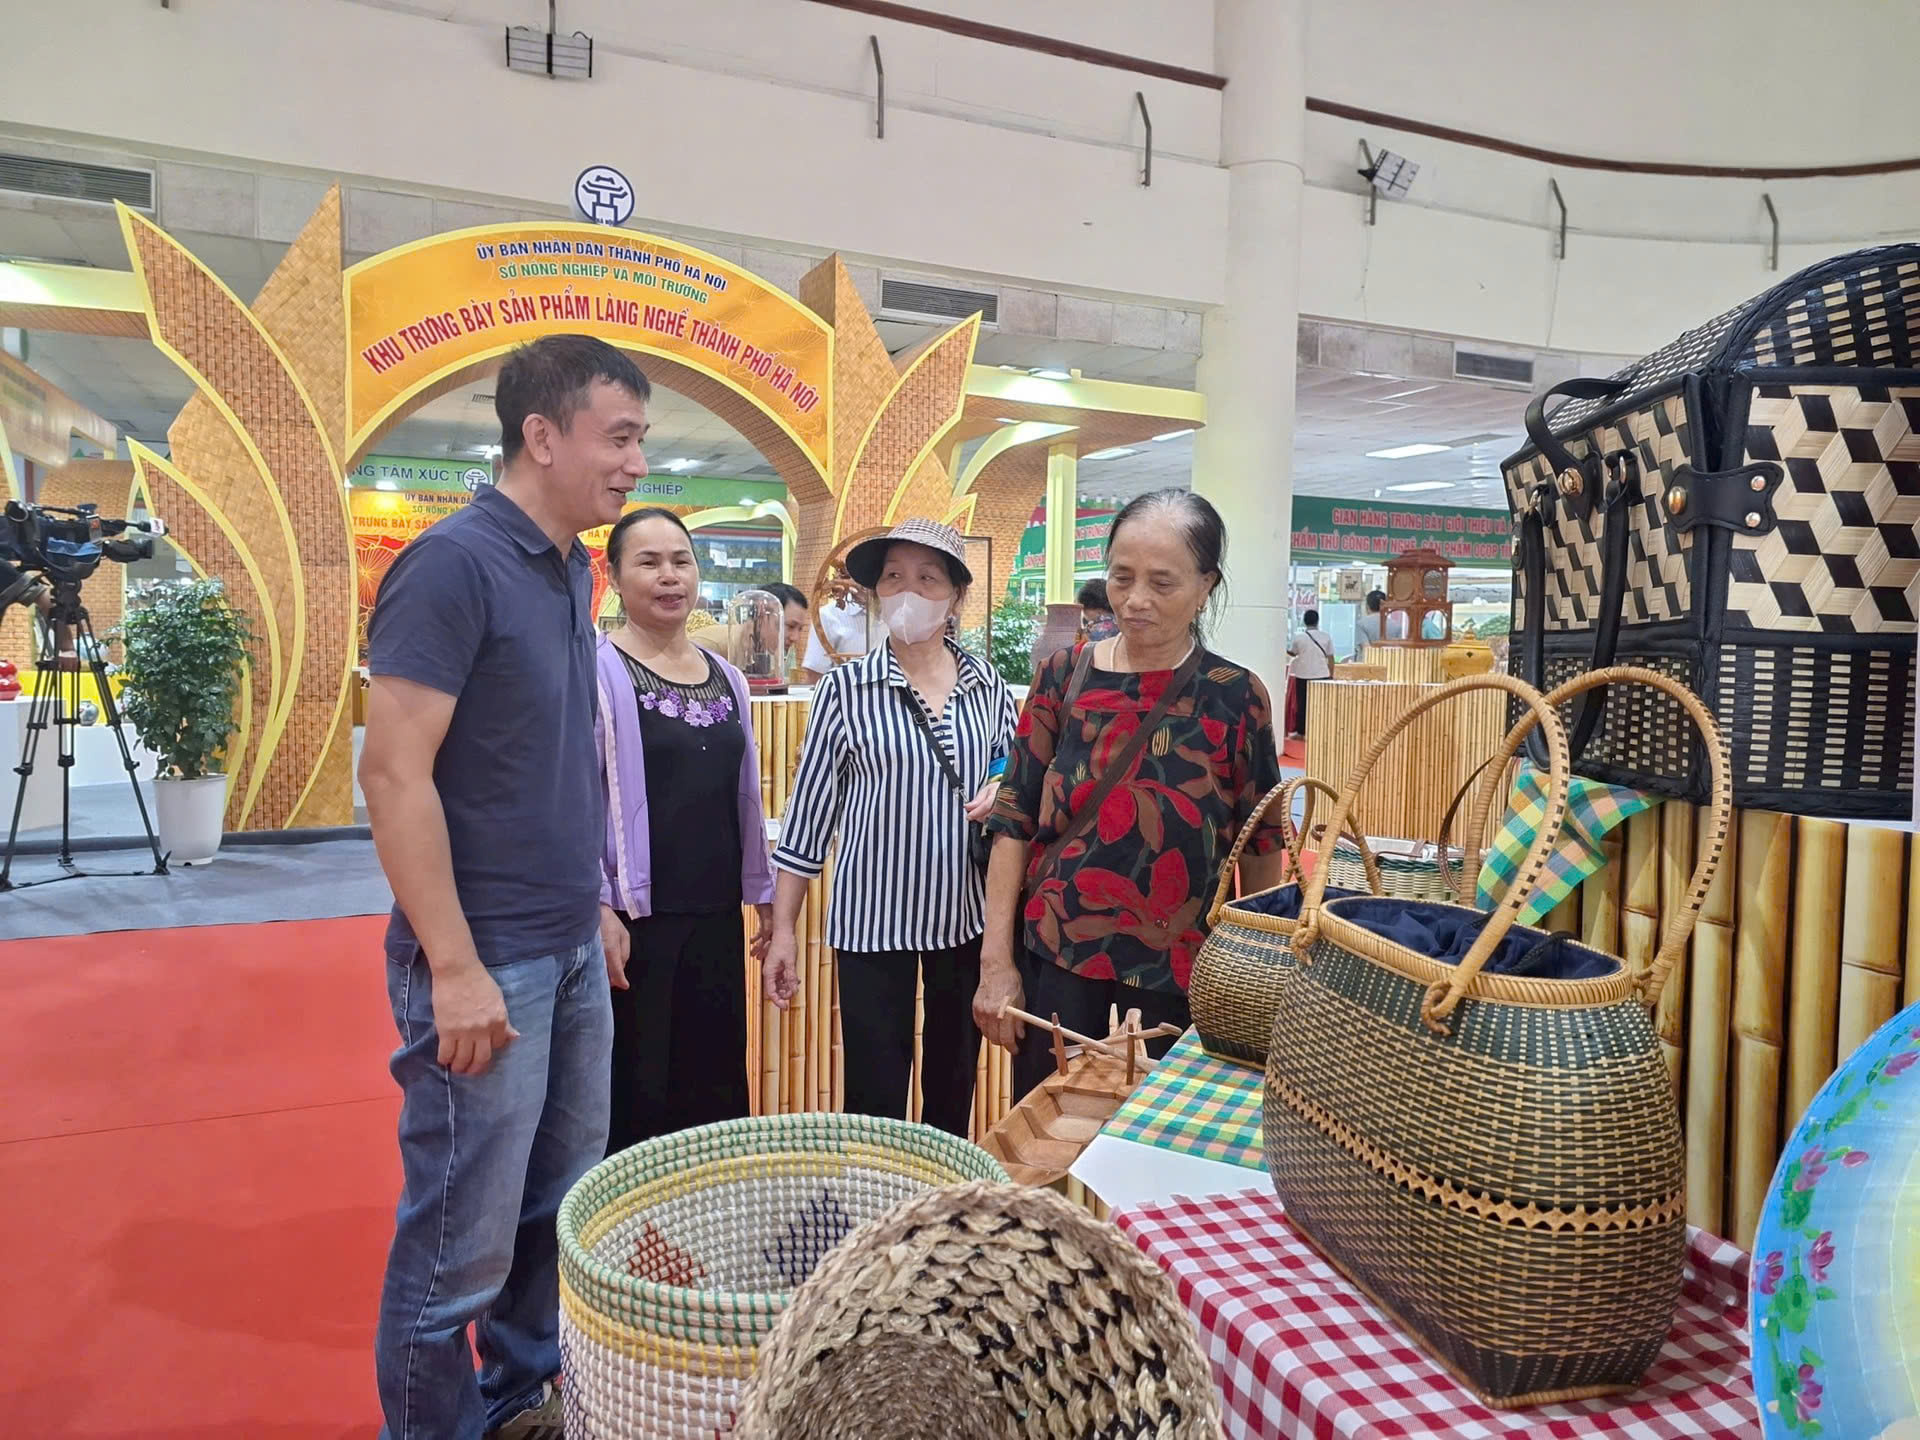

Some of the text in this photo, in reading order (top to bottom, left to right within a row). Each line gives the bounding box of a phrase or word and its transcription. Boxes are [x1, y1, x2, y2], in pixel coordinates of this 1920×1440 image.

[477, 240, 727, 291] ỦY BAN NHÂN DÂN THÀNH PHỐ HÀ NỘI
[499, 261, 708, 304] SỞ NÔNG NGHIỆP VÀ MÔI TRƯỜNG
[362, 284, 819, 414] KHU TRƯNG BÀY SẢN PHẨM LÀNG NGHỀ THÀNH PHỐ HÀ NỘI
[380, 464, 413, 480] TÂM
[418, 466, 450, 482] XÚC
[418, 493, 434, 504] BAN
[1333, 508, 1358, 526] GIAN
[1360, 507, 1388, 528] HÀNG
[1390, 512, 1422, 531] TRƯNG
[1319, 529, 1340, 551] THỦ
[1341, 532, 1371, 553] CÔNG
